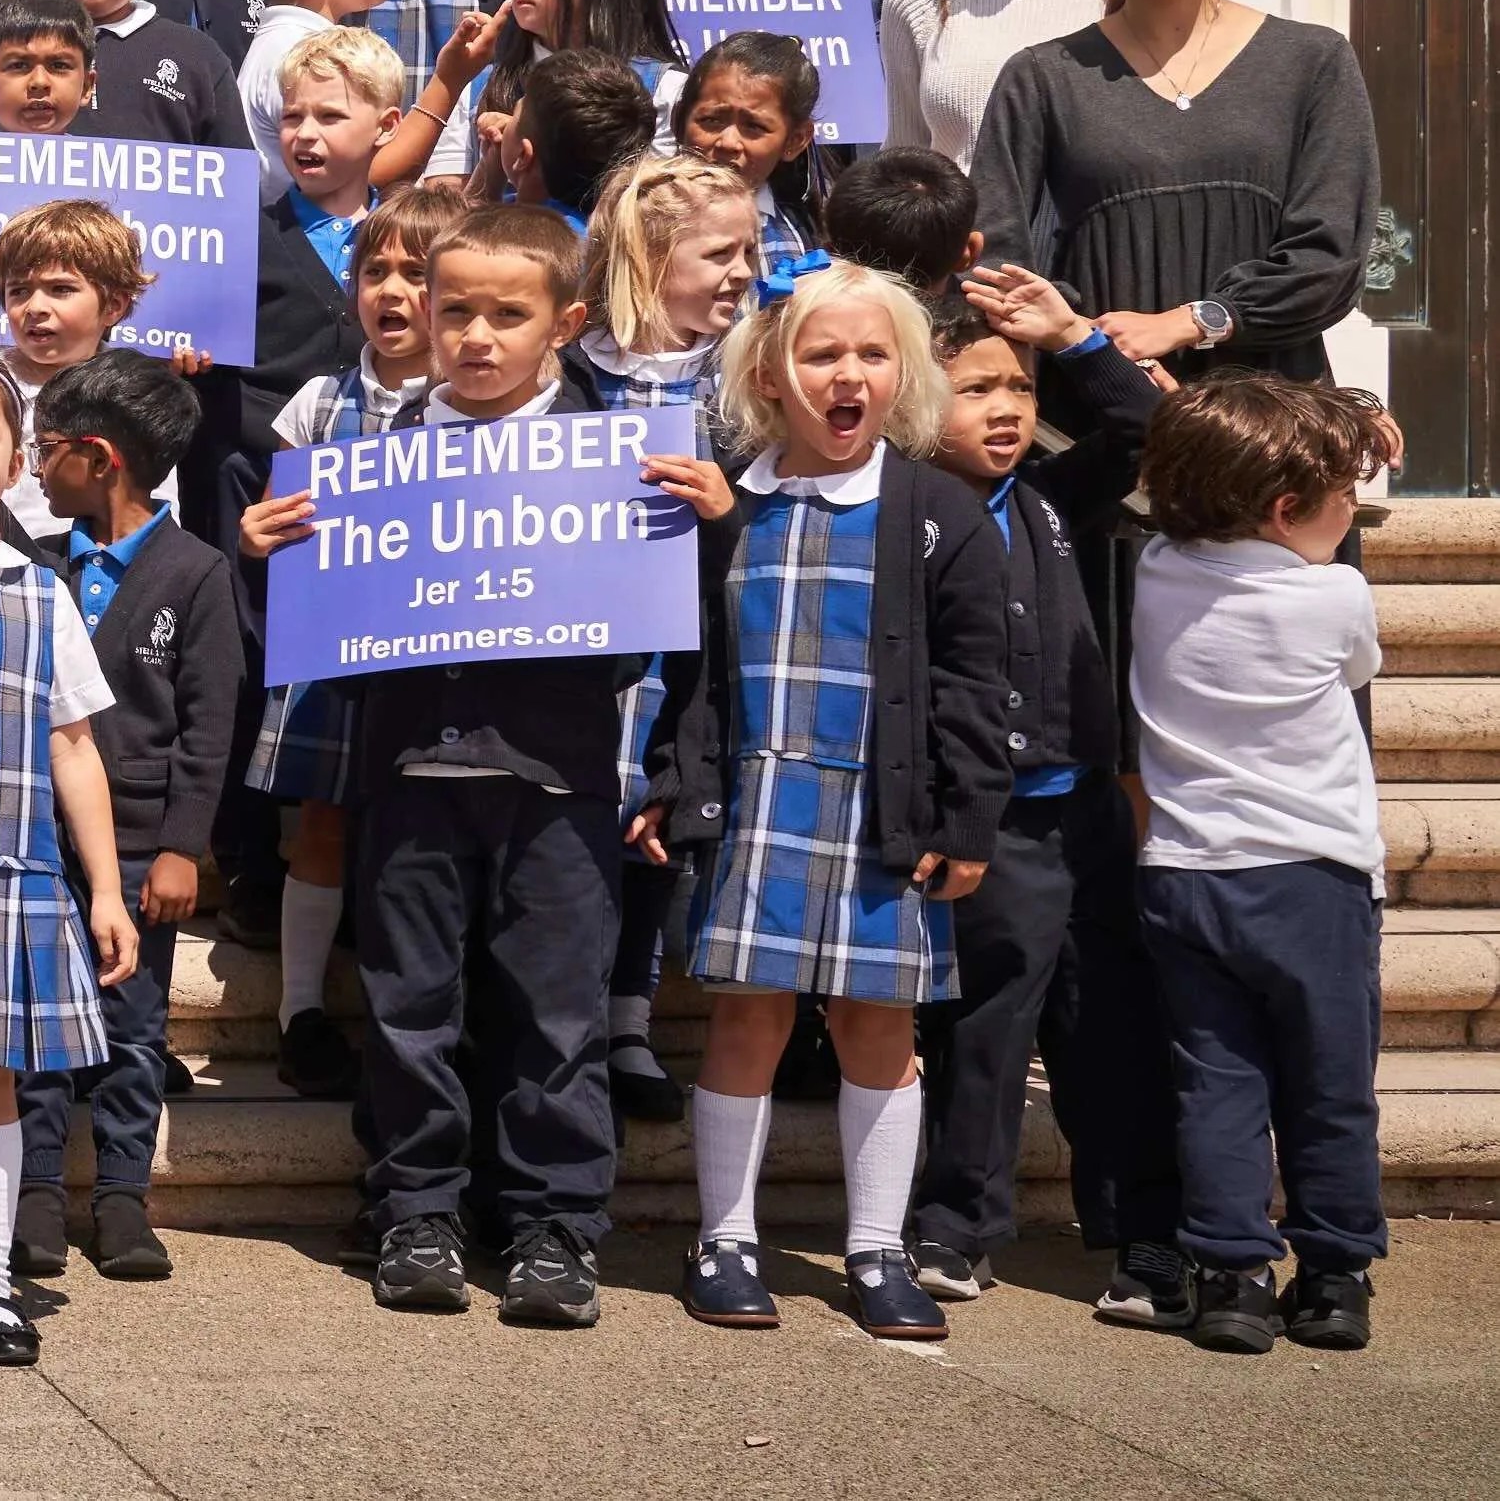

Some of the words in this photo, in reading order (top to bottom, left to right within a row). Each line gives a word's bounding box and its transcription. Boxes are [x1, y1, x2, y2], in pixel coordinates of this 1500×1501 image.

[310, 414, 649, 500] REMEMBER
[313, 515, 410, 571] The
[431, 494, 648, 553] Unborn
[408, 578, 460, 608] Jer
[474, 567, 534, 601] 1:5
[340, 620, 610, 664] liferunners.org
